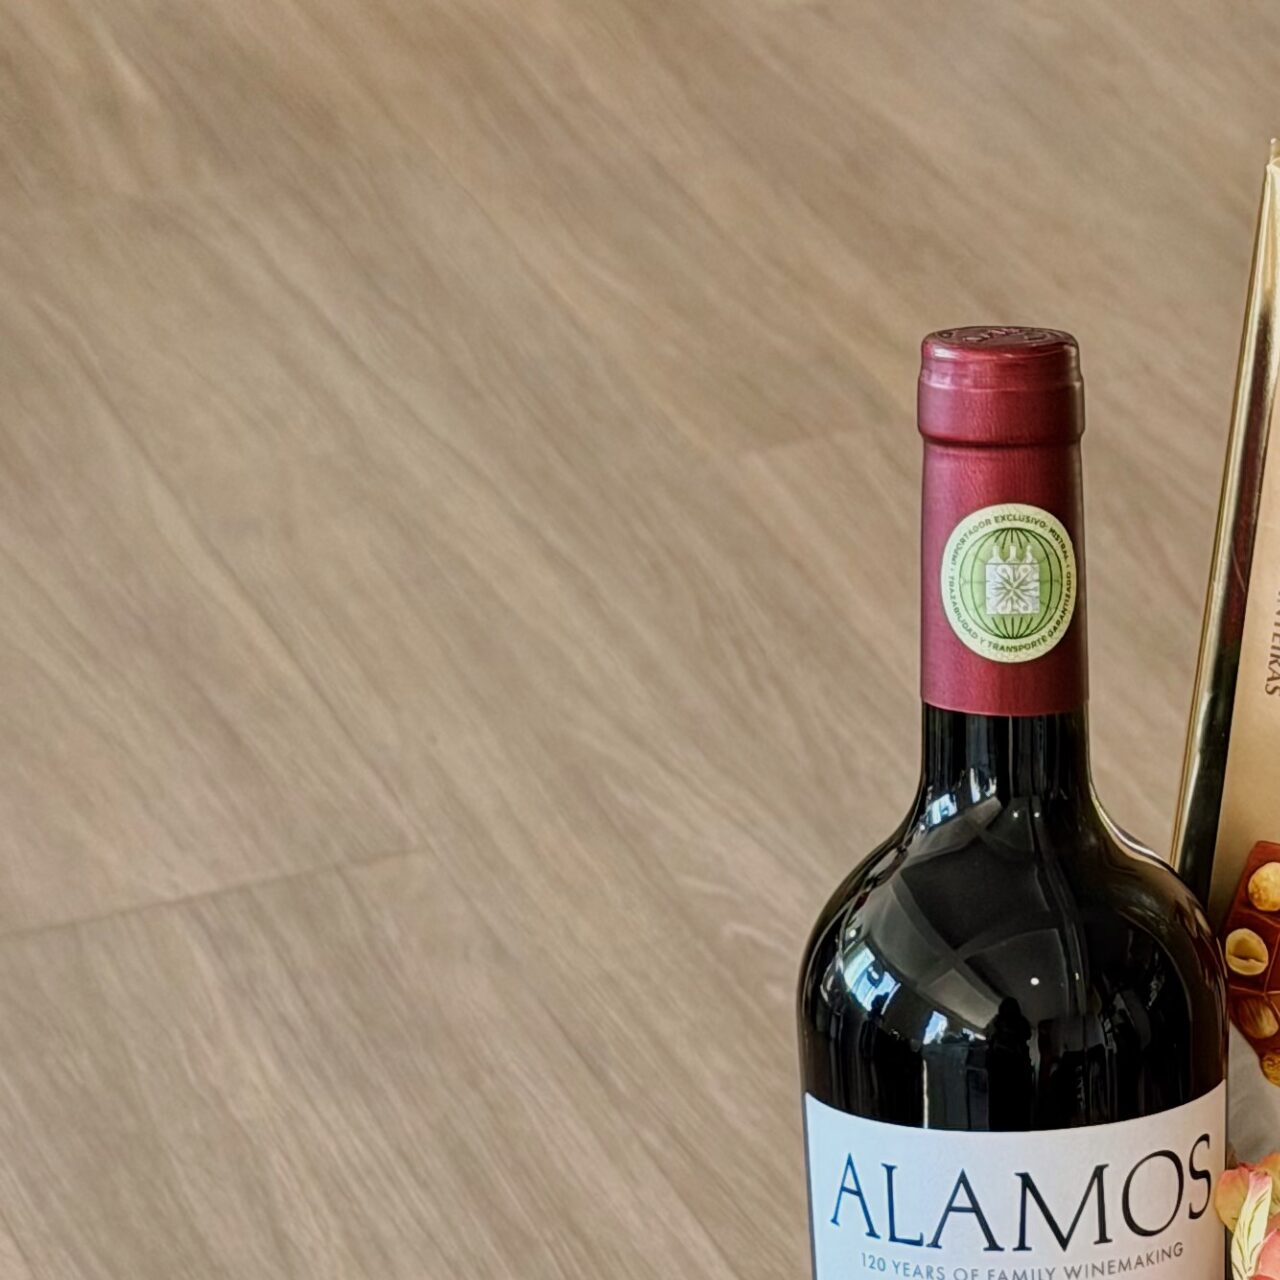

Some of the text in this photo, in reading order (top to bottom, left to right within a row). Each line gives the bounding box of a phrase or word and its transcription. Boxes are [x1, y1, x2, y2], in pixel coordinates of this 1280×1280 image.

[987, 634, 1048, 652] TRANSPORTE
[829, 1132, 1213, 1253] ALAMOS
[861, 1252, 886, 1272] 120
[892, 1260, 945, 1280] YEARS
[1064, 1241, 1185, 1280] WINEMAKING
